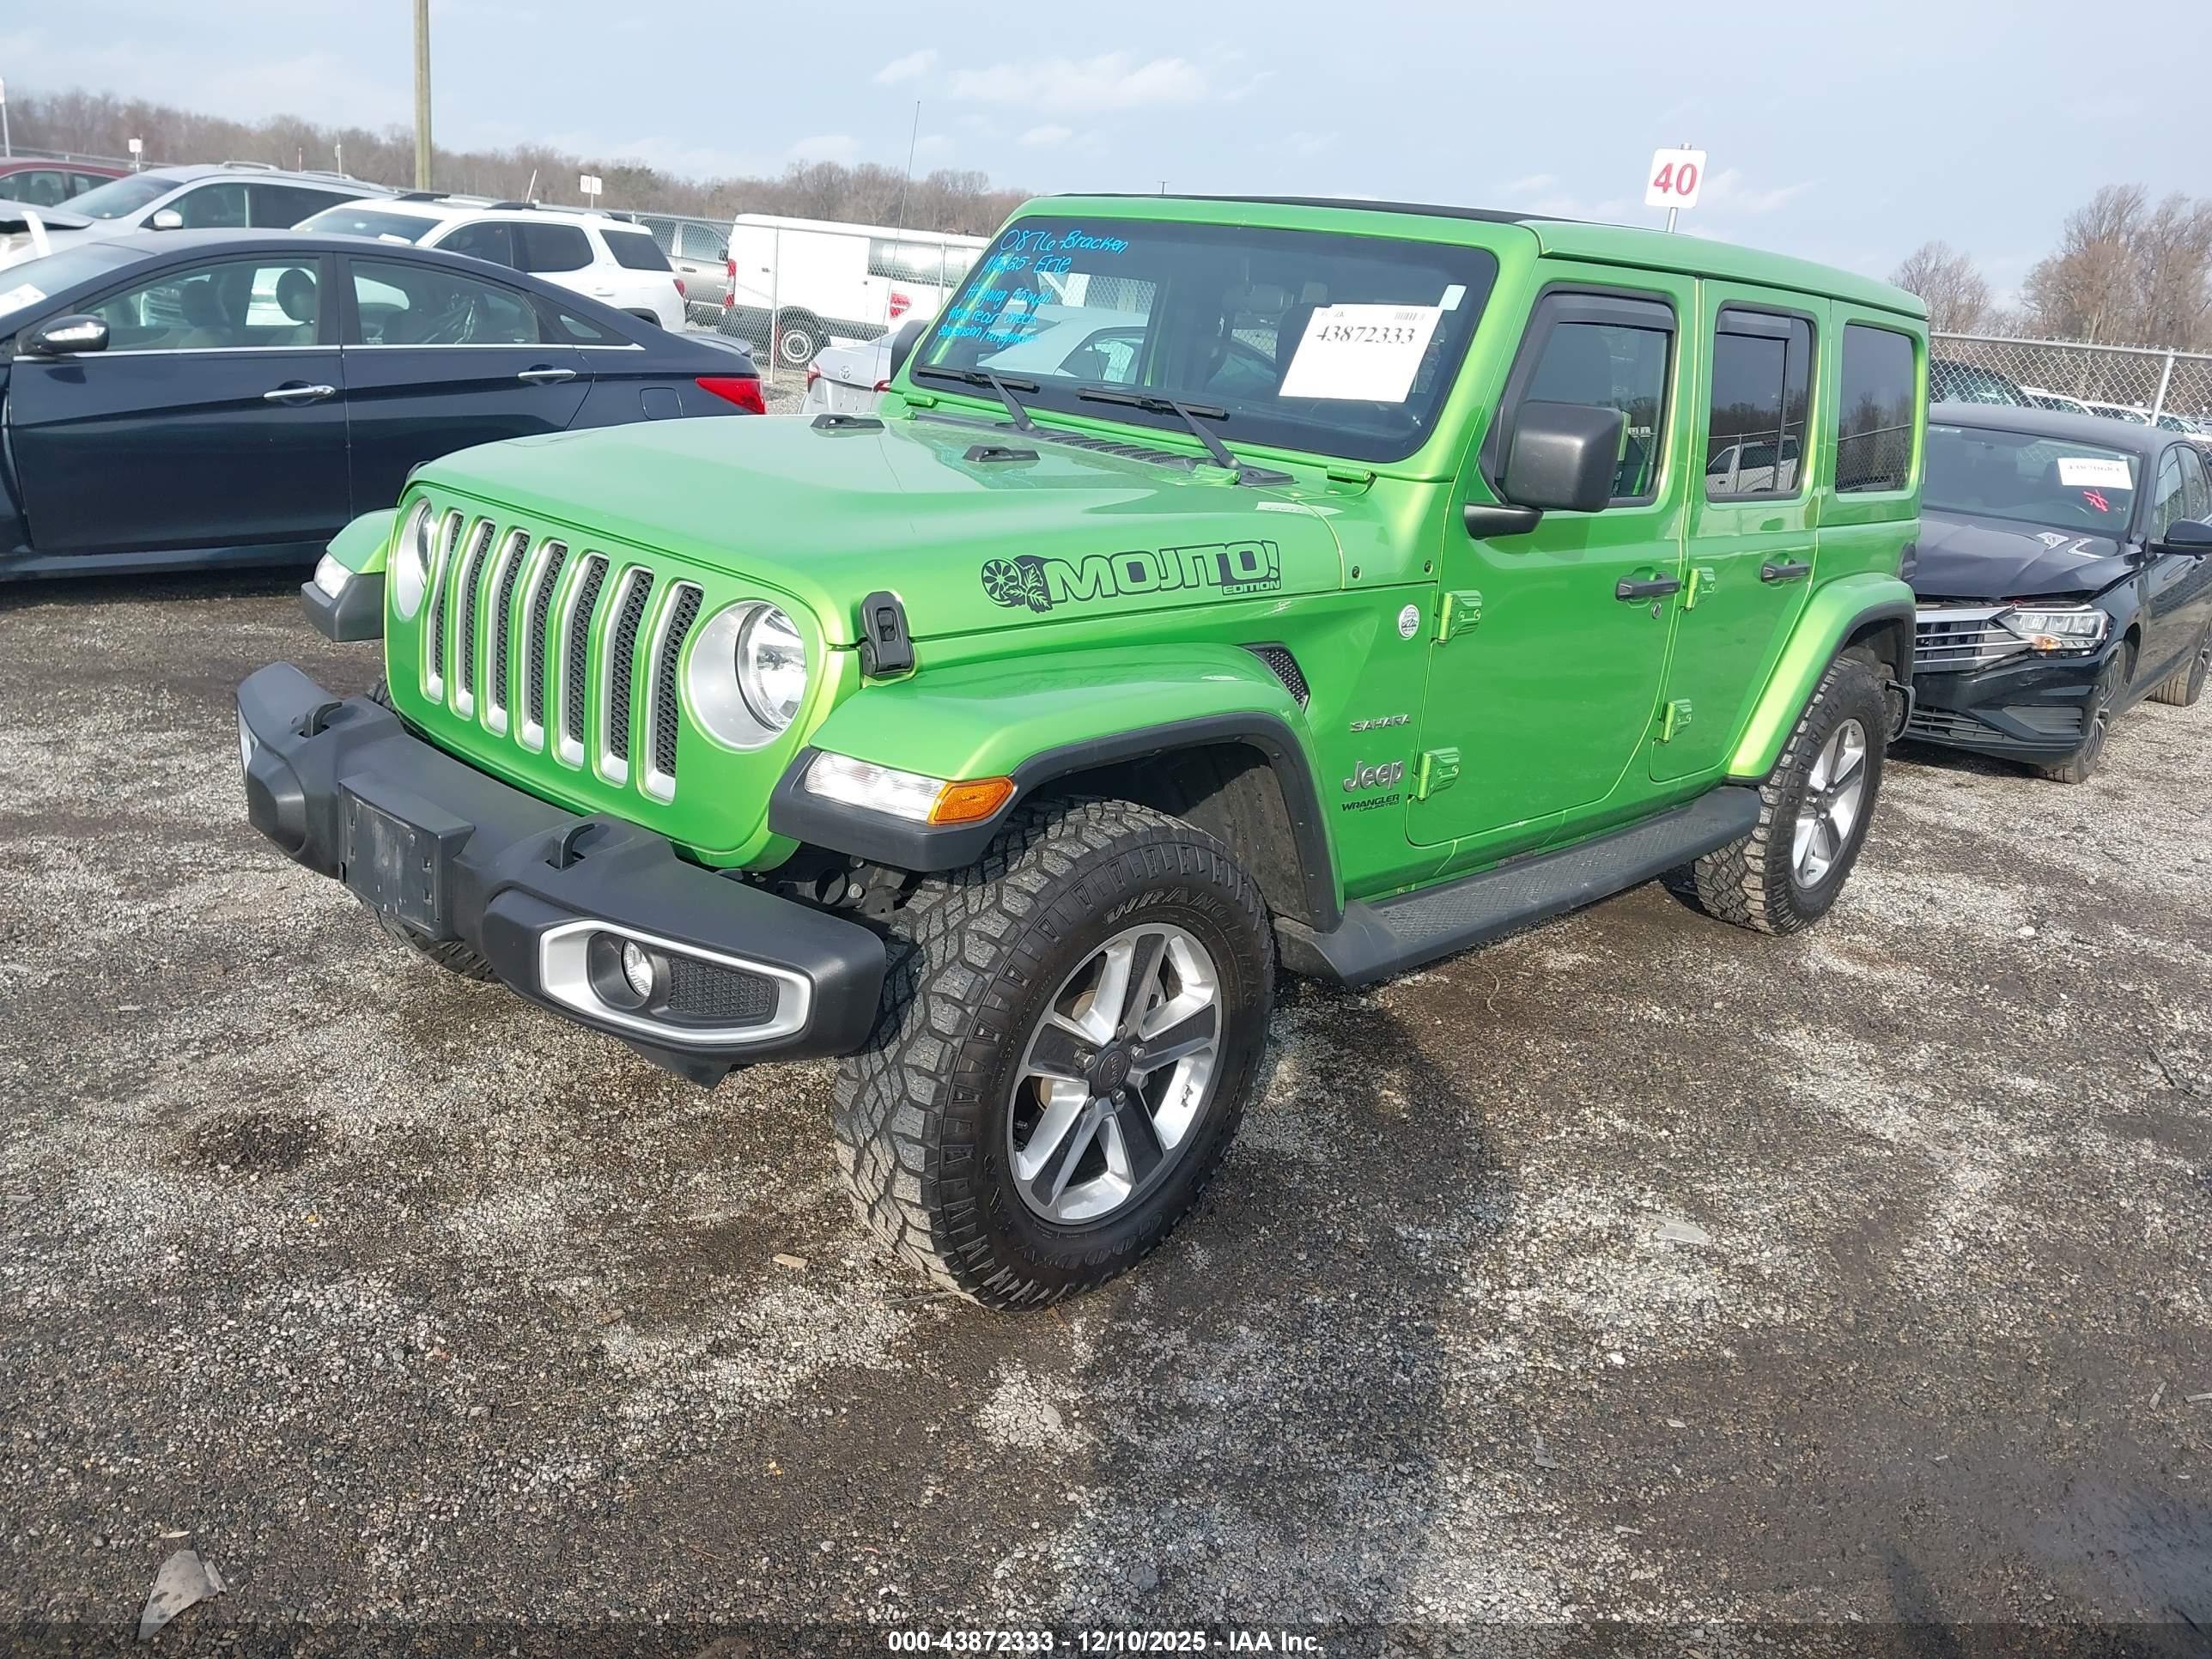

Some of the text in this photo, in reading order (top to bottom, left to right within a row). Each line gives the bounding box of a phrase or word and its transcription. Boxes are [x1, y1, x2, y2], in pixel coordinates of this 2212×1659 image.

[1654, 162, 1698, 196] 40
[1316, 325, 1416, 344] 43872333
[1042, 540, 1280, 604] MOJITO!
[1224, 580, 1280, 595] EDITION
[1349, 714, 1411, 732] SAHARA
[1342, 760, 1404, 793] Jeep
[1341, 793, 1400, 812] WRANGLER
[1359, 801, 1400, 813] UNLIMITED
